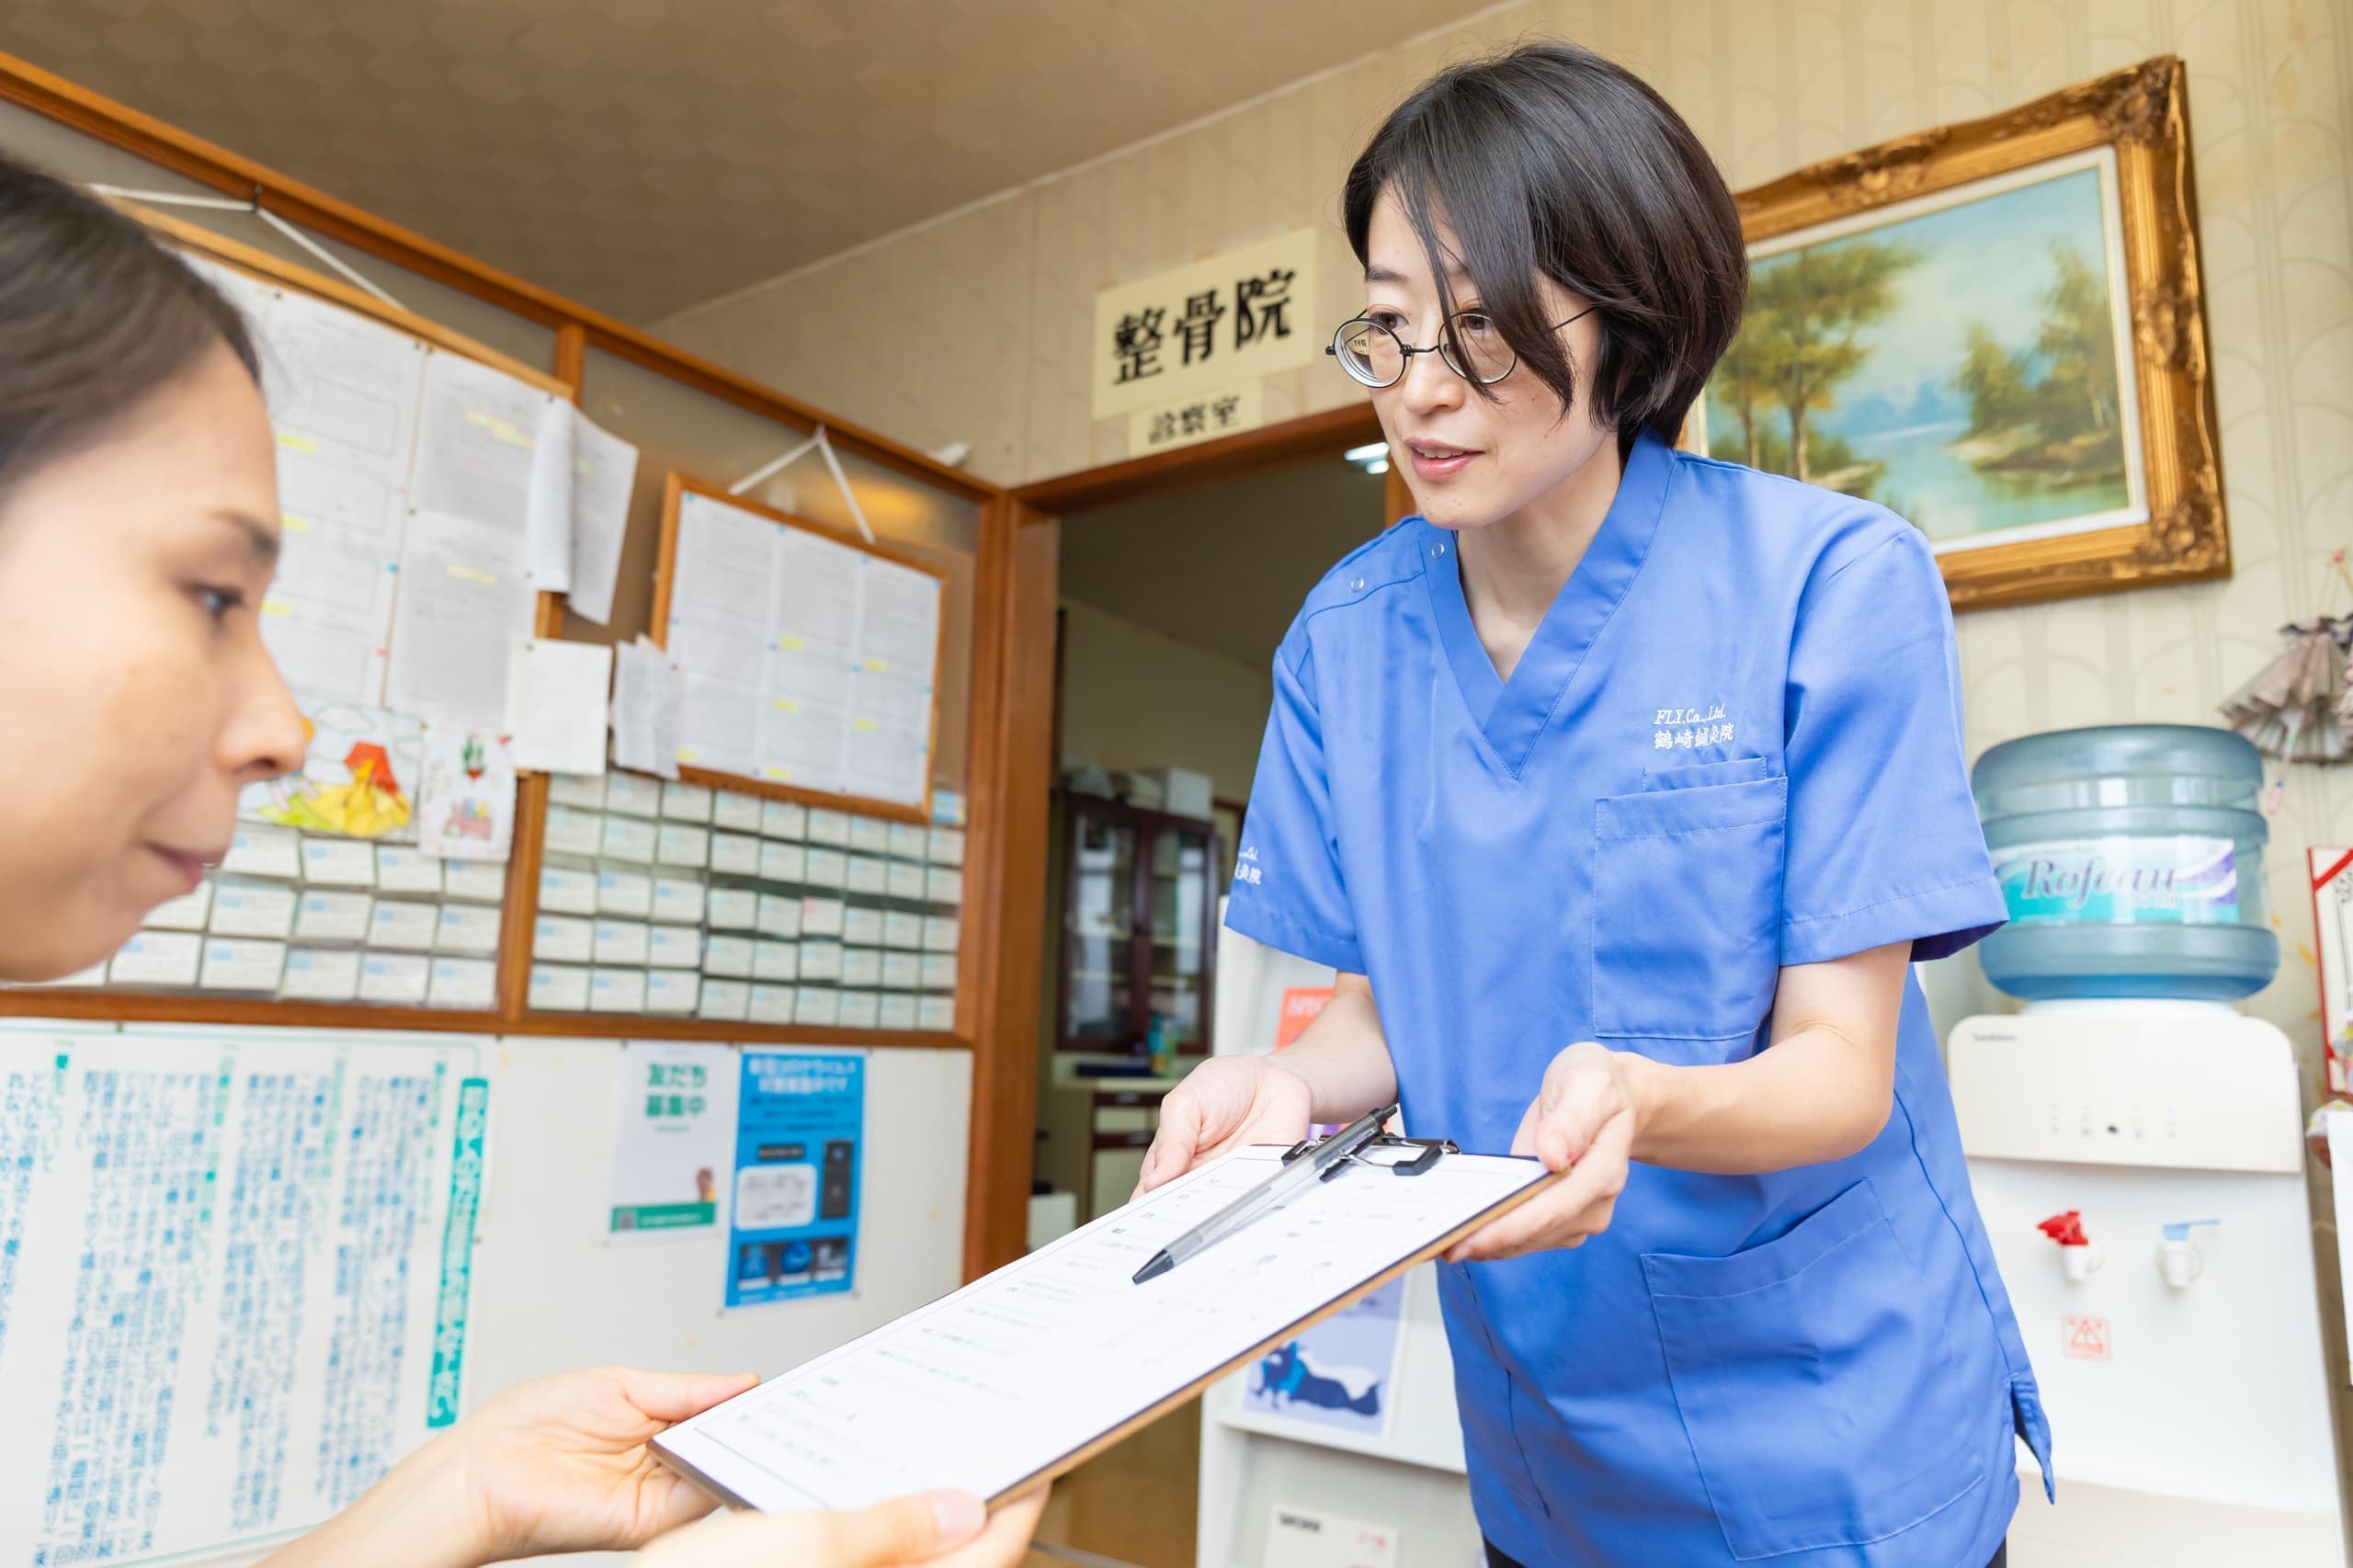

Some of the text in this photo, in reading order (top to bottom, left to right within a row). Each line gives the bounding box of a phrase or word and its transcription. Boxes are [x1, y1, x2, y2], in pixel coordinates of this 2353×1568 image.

[1113, 268, 1296, 386] 整骨院
[1149, 395, 1241, 445] 診察室
